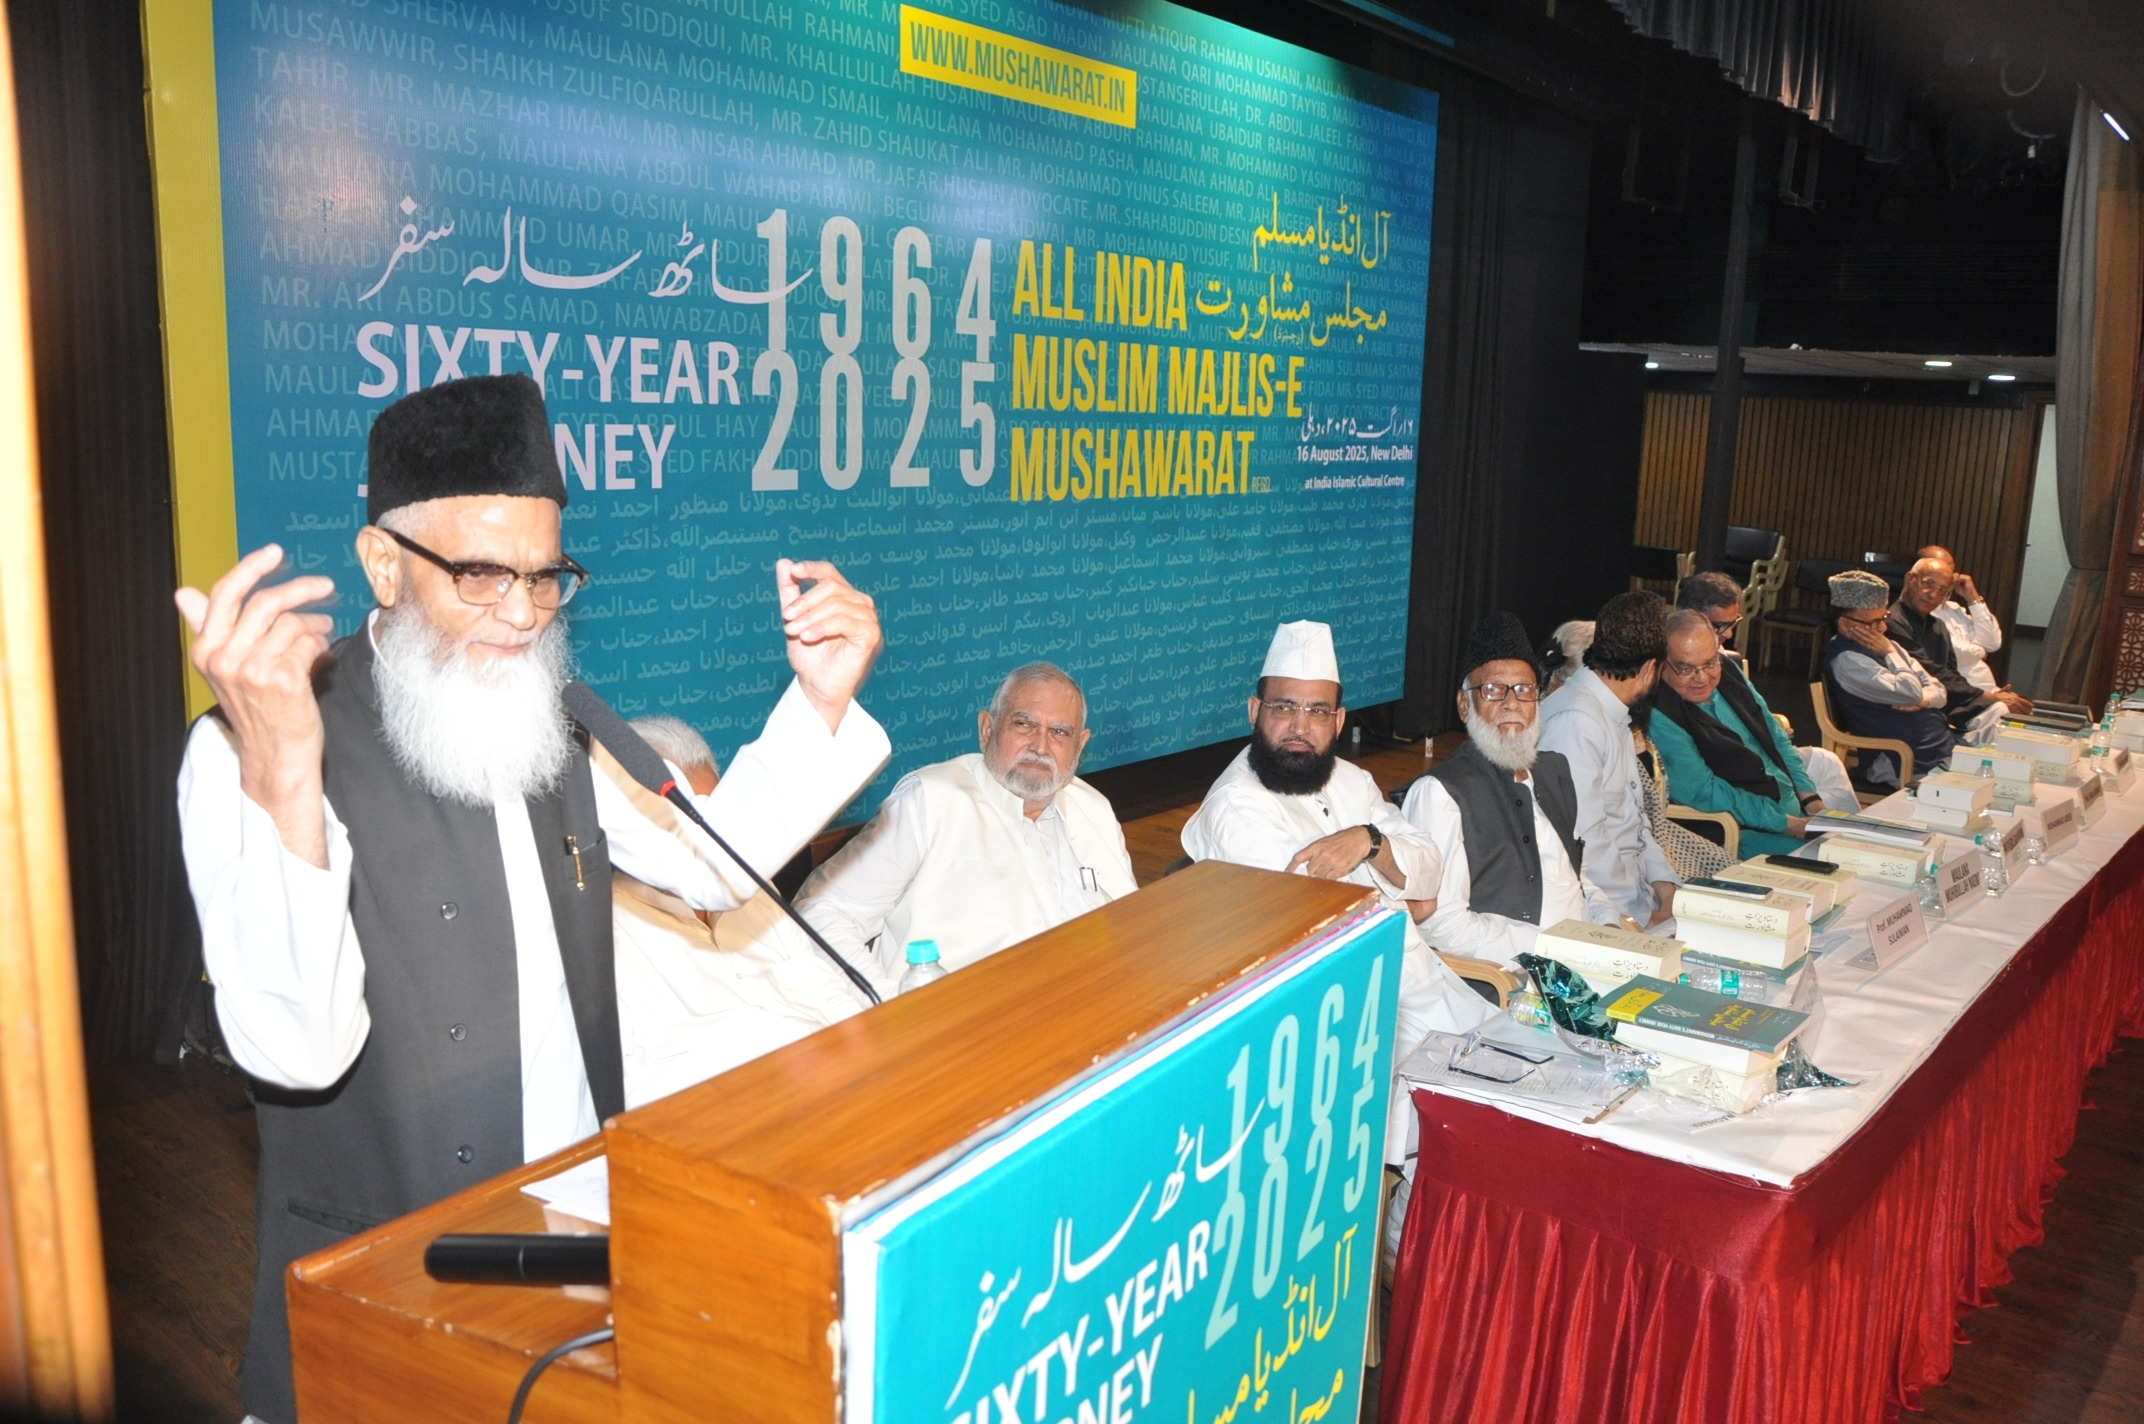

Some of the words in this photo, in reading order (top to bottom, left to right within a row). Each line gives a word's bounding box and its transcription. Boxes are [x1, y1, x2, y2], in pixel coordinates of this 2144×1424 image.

[620, 1, 730, 54] SIDDIQUI,
[741, 30, 778, 63] MR.
[786, 41, 915, 94] KHALILULLAH
[922, 76, 995, 116] HUSAINI,
[1002, 96, 1078, 132] MAULANA
[1083, 116, 1131, 144] ABDUR
[1136, 128, 1196, 162] RAHMAN,
[1200, 144, 1222, 166] MR.
[1226, 150, 1297, 182] MOHAMMAD
[1301, 169, 1330, 190] YASIN
[909, 21, 1127, 115] WWW.MUSHAWARAT.IN
[1006, 6, 1047, 38] ASAD
[1110, 38, 1177, 76] MAULANA
[1181, 59, 1211, 88] QARI
[1214, 69, 1288, 108] MOHAMMAD
[1290, 93, 1329, 122] TAYYIB,
[1149, 23, 1196, 58] ATIQUR
[1200, 39, 1253, 73] RAHMAN
[1256, 57, 1302, 90] USMANI,
[250, 0, 444, 73] MUSAWWIR,
[452, 42, 554, 88] SHAIKH
[562, 65, 759, 131] ZULFIQARULLAH,
[771, 107, 808, 138] MR.
[813, 116, 872, 149] ZAHID
[877, 128, 959, 166] SHAUKAT
[963, 146, 992, 175] ALI,
[998, 153, 1026, 178] MR.
[1030, 161, 1121, 197] MOHAMMAD
[1125, 180, 1169, 206] YUNUS
[1172, 189, 1222, 219] SALEEM,
[1225, 200, 1246, 221] MR.
[369, 69, 423, 107] MR.
[432, 81, 551, 128] MAZHAR
[559, 104, 634, 146] IMAM,
[643, 119, 684, 150] MR.
[693, 128, 756, 162] NISAR
[760, 140, 841, 180] AHMAD,
[848, 157, 882, 183] MR.
[885, 163, 938, 193] JAFAR
[944, 175, 1005, 205] HUSAIN
[1010, 187, 1091, 222] ADVOCATE,
[1096, 203, 1120, 225] MR.
[1124, 208, 1216, 241] SHAHABUDDIN
[543, 21, 669, 74] MAULANA
[678, 51, 814, 104] MOHAMMAD
[822, 84, 889, 123] ISMAIL,
[896, 101, 982, 139] MAULANA
[988, 122, 1084, 162] MOHAMMAD
[1089, 144, 1138, 176] PASHA,
[1144, 157, 1206, 187] MAULANA
[1209, 171, 1253, 198] AHMAD
[1139, 102, 1202, 135] MAULANA
[1209, 120, 1262, 150] UBAIDUR
[1267, 136, 1318, 165] RAHMAN,
[1323, 150, 1371, 177] MAULANA
[1245, 104, 1264, 126] DR.
[1268, 111, 1304, 137] ABDUL
[1308, 122, 1342, 146] JALEEL
[430, 164, 602, 213] MOHAMMAD
[611, 189, 693, 227] QASIM,
[498, 133, 628, 179] MAULANA
[636, 155, 715, 191] ABDUL
[724, 170, 800, 204] WAHAB
[884, 195, 945, 225] BEGUM
[1074, 226, 1099, 248] MR.
[1104, 232, 1187, 261] MOHAMMAD
[1191, 246, 1233, 270] YUSUF,
[1253, 191, 1315, 272] مسلم
[357, 195, 455, 301] سفر
[756, 208, 997, 362] 1964
[1012, 239, 1085, 323] ALL
[1096, 249, 1188, 331] INDIA
[262, 275, 320, 308] MR.
[395, 285, 493, 319] ABDUS
[502, 293, 604, 329] SAMAD,
[614, 302, 761, 336] NAWABZADA
[1196, 271, 1311, 341] مشاورت
[1310, 280, 1387, 347] مجلس
[356, 321, 742, 406] SIXTY-YEAR
[1012, 333, 1158, 417] MUSLIM
[1167, 341, 1305, 418] MAJLIS-E
[752, 350, 997, 492] 2025
[1010, 426, 1255, 502] MUSHAWARAT
[1297, 446, 1309, 462] 16
[1310, 445, 1343, 465] August
[1344, 445, 1369, 463] 2025,
[1371, 446, 1390, 462] New
[1391, 444, 1413, 461] Delhi
[1305, 478, 1314, 489] at
[1314, 477, 1332, 489] India
[1332, 477, 1357, 489] Islamic
[1357, 476, 1384, 488] Cultural
[1383, 475, 1405, 487] Centre
[1227, 953, 1385, 1193] 1964
[1205, 1079, 1375, 1351] 2025
[1314, 1222, 1359, 1341] آل
[944, 1270, 1022, 1411] سفر
